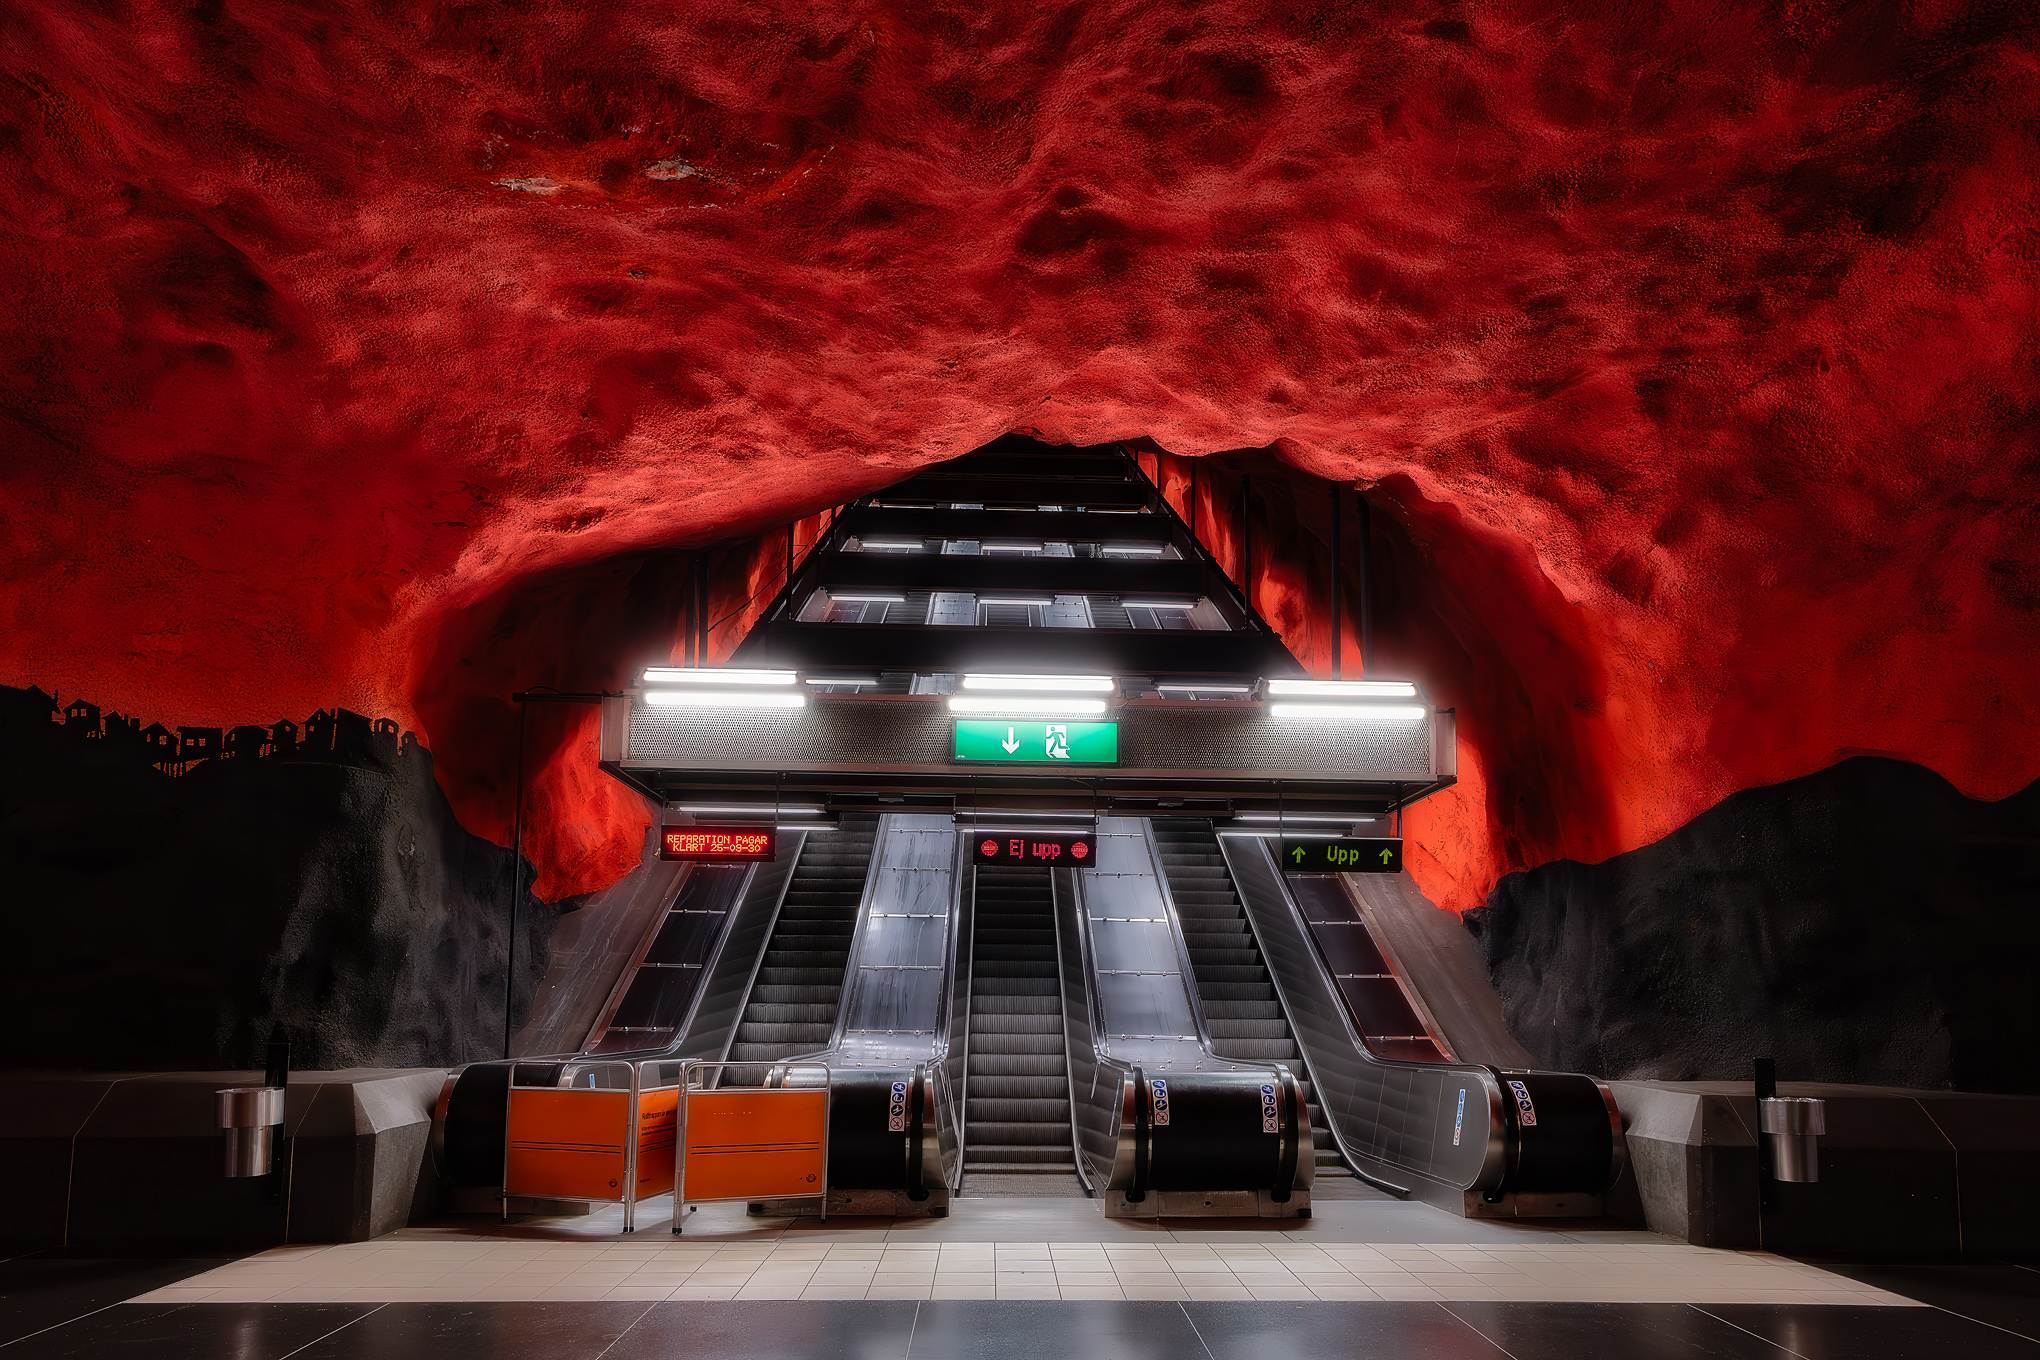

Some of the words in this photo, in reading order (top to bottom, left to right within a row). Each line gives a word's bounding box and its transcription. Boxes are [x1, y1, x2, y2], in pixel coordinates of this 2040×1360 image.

[667, 834, 730, 844] REPARATION
[673, 843, 705, 852] KLART
[710, 843, 761, 853] 25-09-30
[1009, 839, 1024, 859] Ej
[1032, 843, 1061, 860] upp
[1327, 845, 1359, 865] Upp
